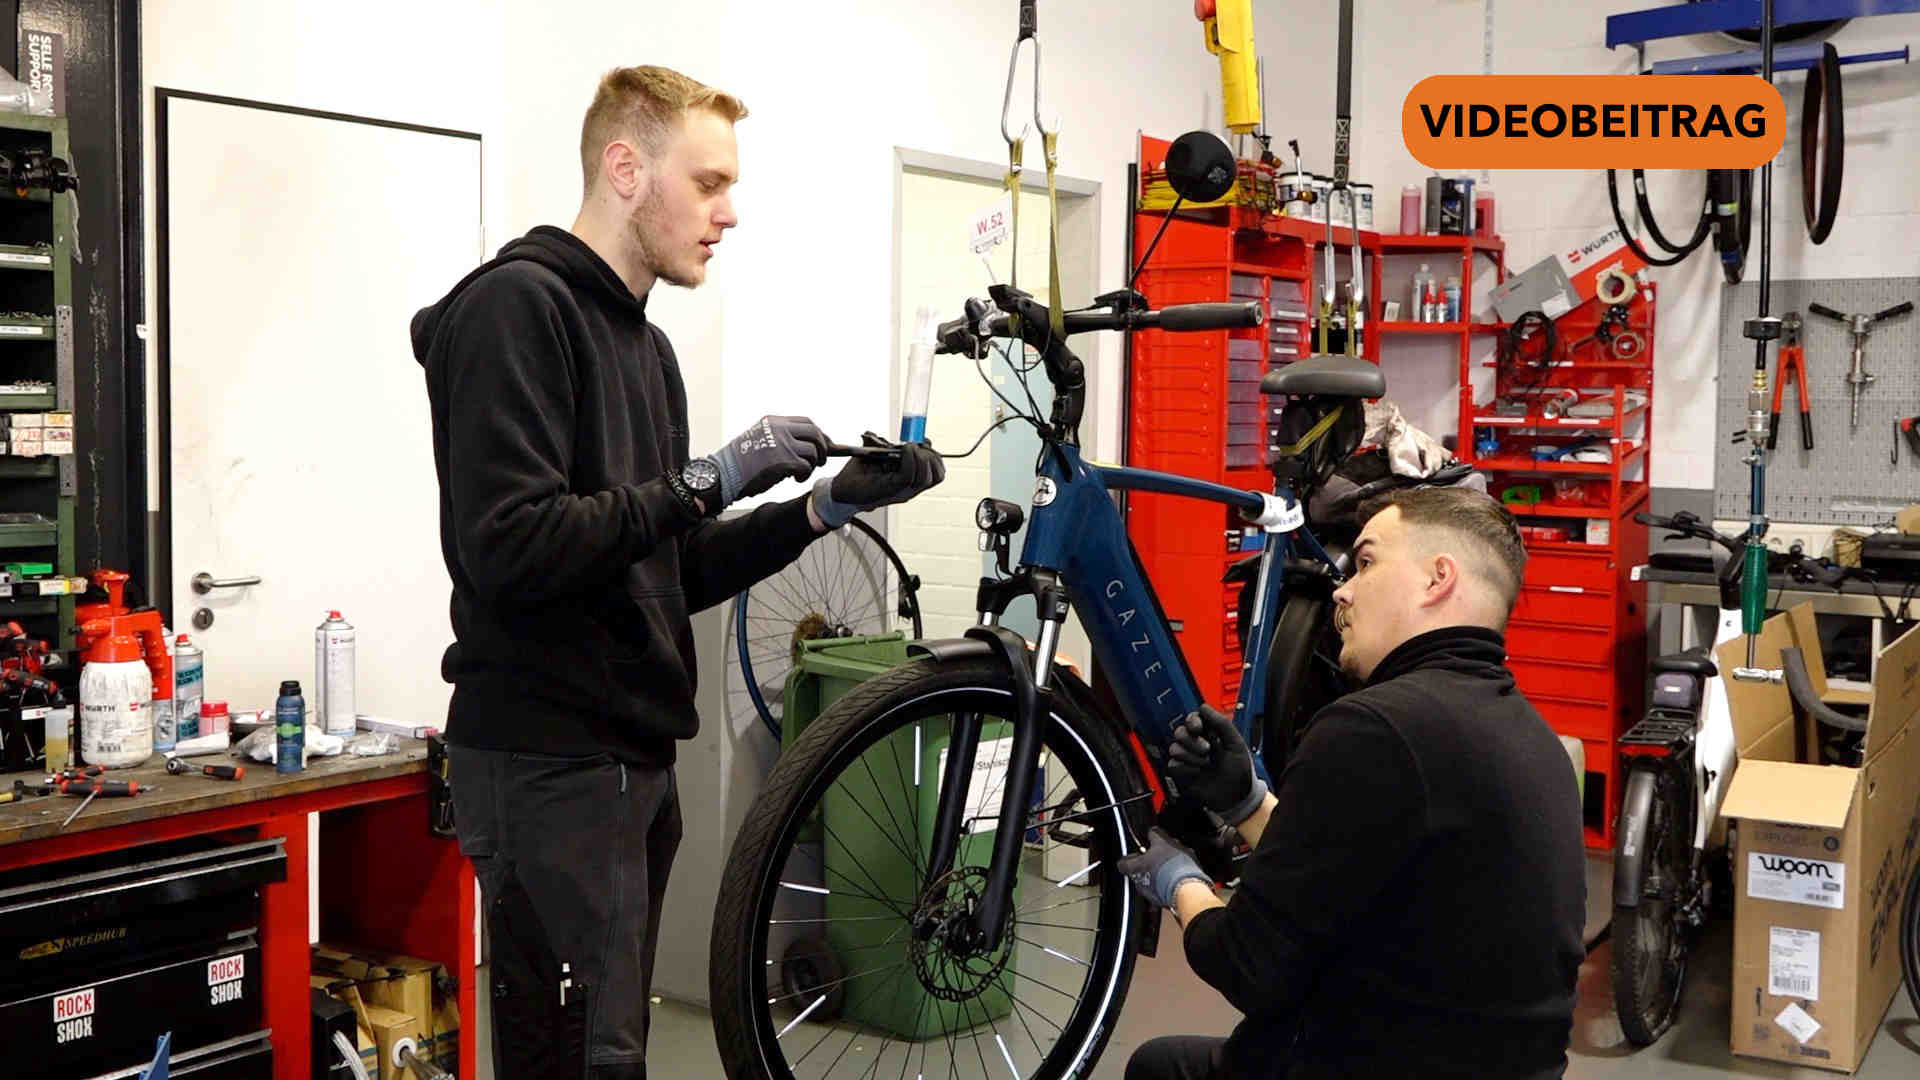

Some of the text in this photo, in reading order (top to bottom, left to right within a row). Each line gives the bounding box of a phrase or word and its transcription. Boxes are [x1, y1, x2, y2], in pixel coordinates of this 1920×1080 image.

[40, 34, 53, 72] SELLE
[1105, 579, 1185, 731] GAZELL
[1757, 855, 1834, 879] woom
[211, 958, 243, 982] ROCK
[57, 991, 93, 1019] ROCK
[211, 979, 243, 1006] SHOX
[56, 1015, 94, 1044] SHOX
